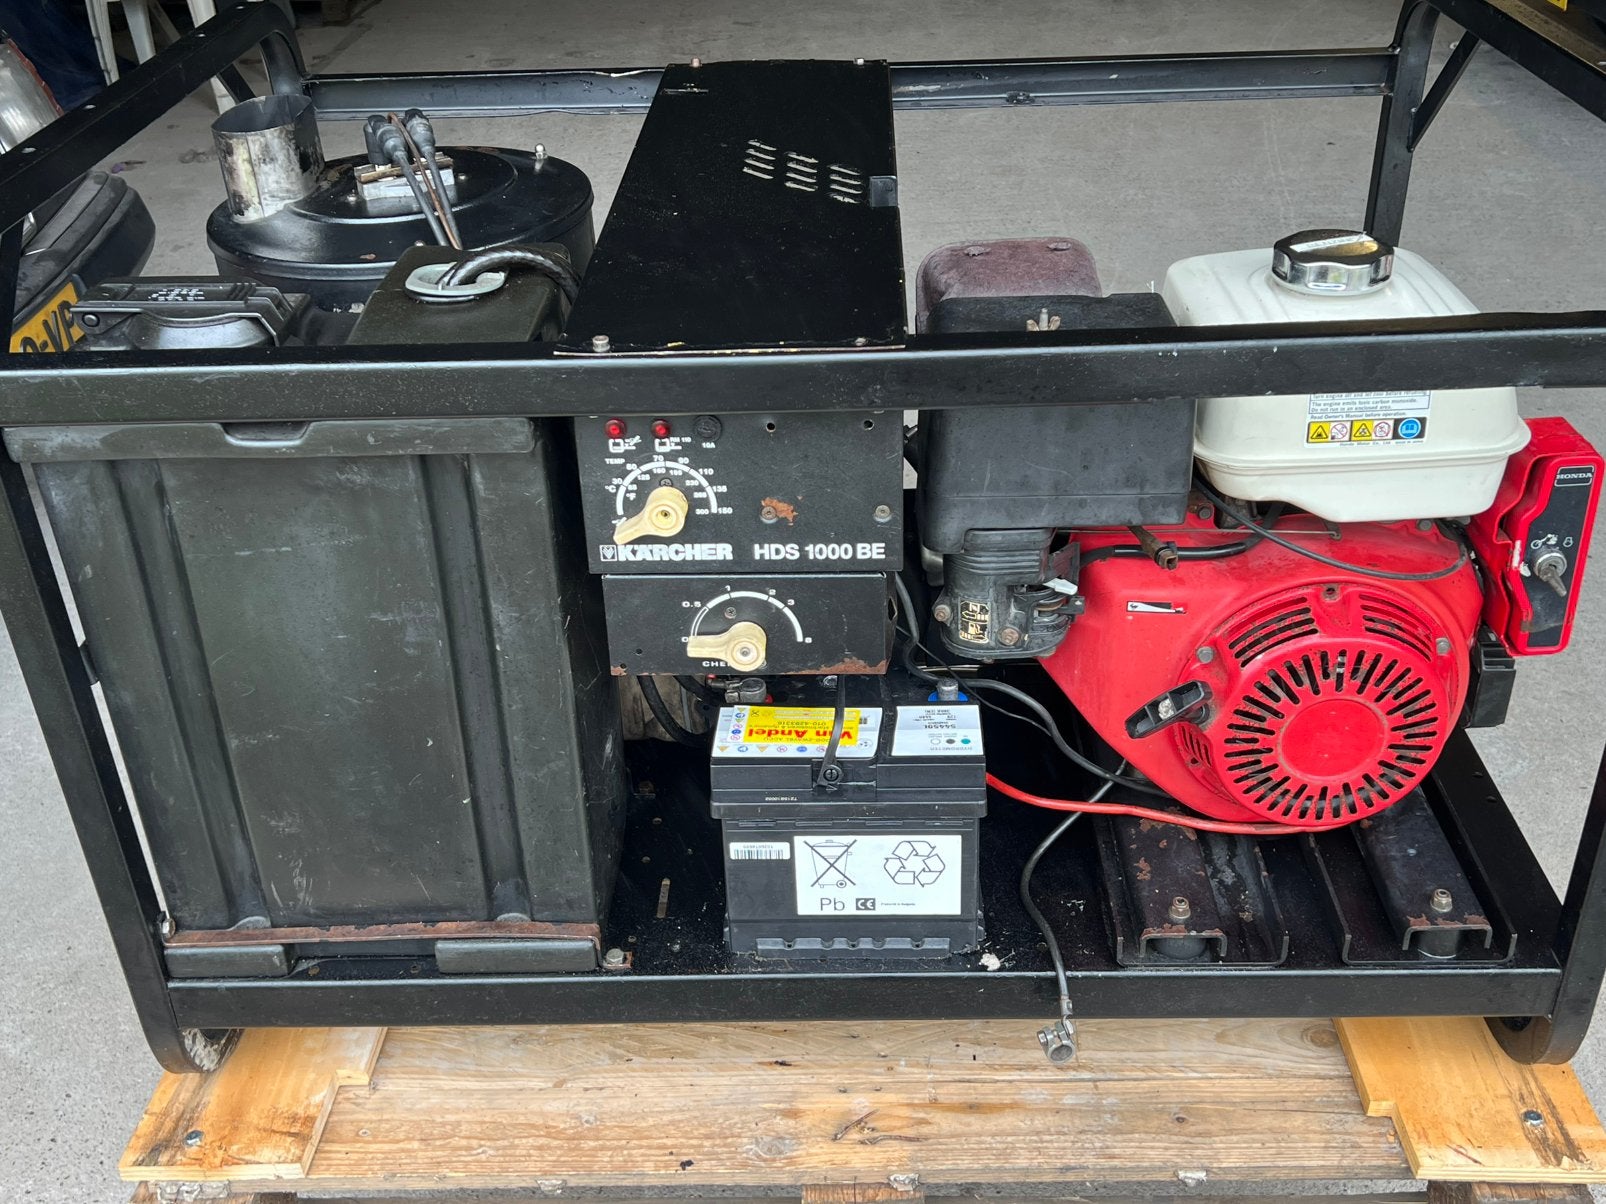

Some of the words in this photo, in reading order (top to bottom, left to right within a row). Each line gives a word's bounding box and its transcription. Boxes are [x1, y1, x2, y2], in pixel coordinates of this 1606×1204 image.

[653, 454, 665, 462] 70
[698, 467, 715, 476] 110
[1556, 472, 1593, 480] HONDA
[611, 477, 623, 485] 30
[712, 485, 728, 493] 135
[753, 542, 801, 561] HDS
[804, 542, 854, 561] 1000
[856, 542, 886, 560] BE
[724, 584, 732, 592] 1
[681, 600, 702, 608] 0.5
[787, 598, 796, 606] 3
[701, 660, 732, 668] CHE
[748, 728, 808, 738] Andel
[820, 897, 846, 912] Pb
[857, 899, 875, 911] CE
